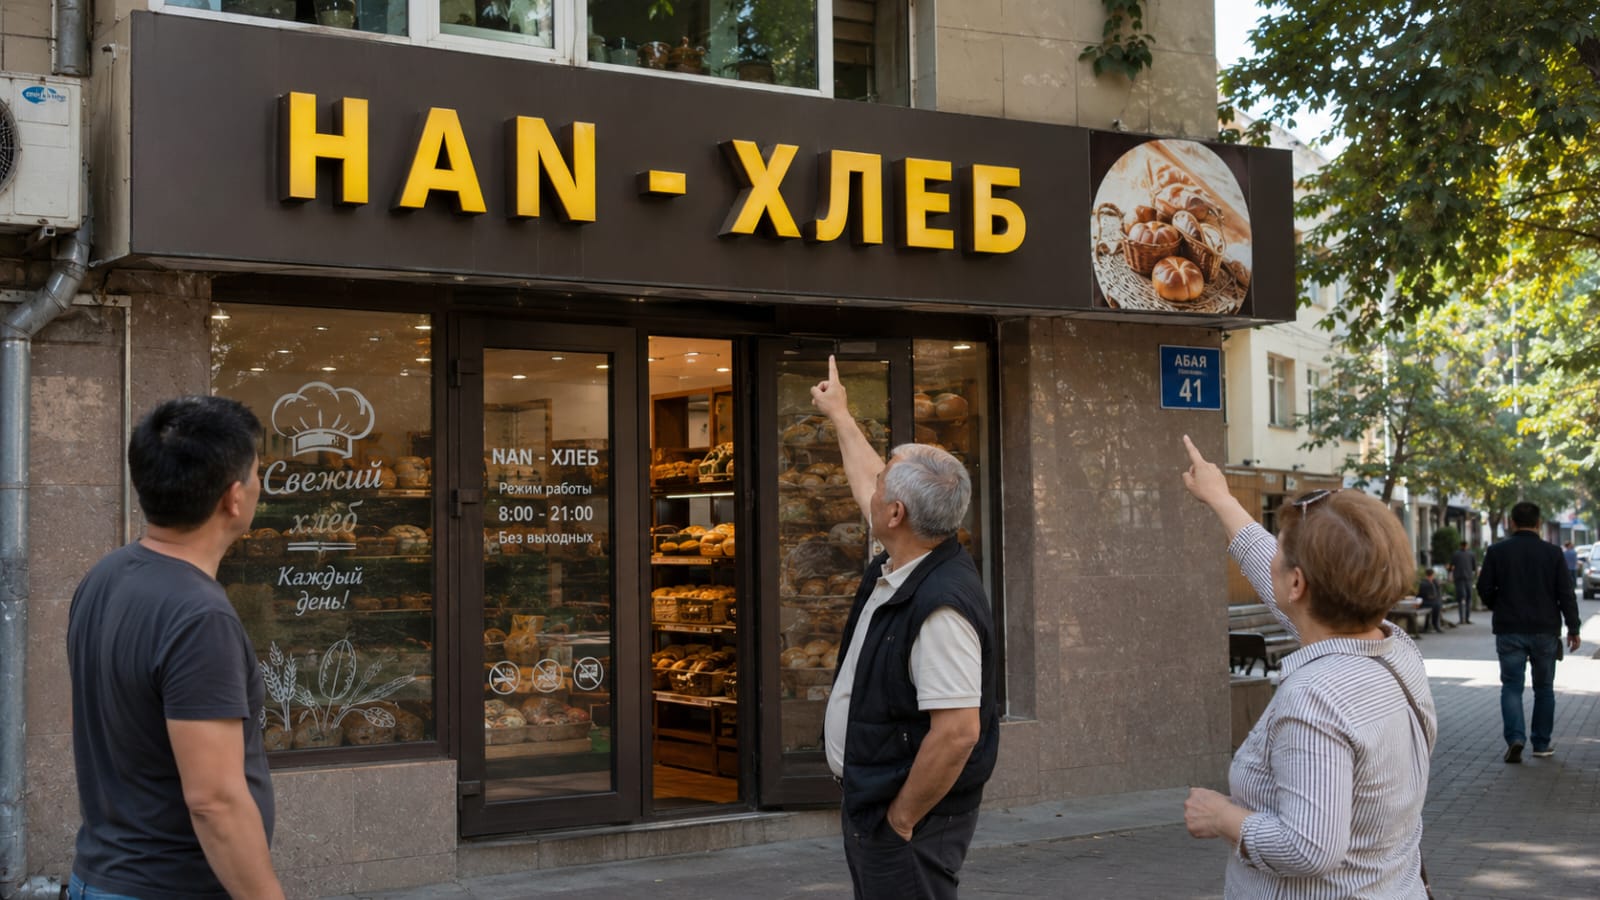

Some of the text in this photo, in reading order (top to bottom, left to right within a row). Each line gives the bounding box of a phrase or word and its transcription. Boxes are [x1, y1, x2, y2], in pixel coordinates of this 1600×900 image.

[722, 138, 1027, 254] ХЛЕБ
[1174, 353, 1207, 368] АБАЯ
[1179, 377, 1202, 403] 41
[492, 447, 533, 465] NAN
[551, 448, 599, 466] ХЛЕБ
[263, 460, 384, 495] Свежий
[499, 481, 592, 497] Режим работы
[289, 500, 364, 535] хлеб
[498, 505, 534, 522] 8:00
[550, 505, 594, 521] 21:00
[498, 531, 594, 545] Без выходных
[277, 565, 363, 590] Каждый
[295, 590, 350, 616] день!
